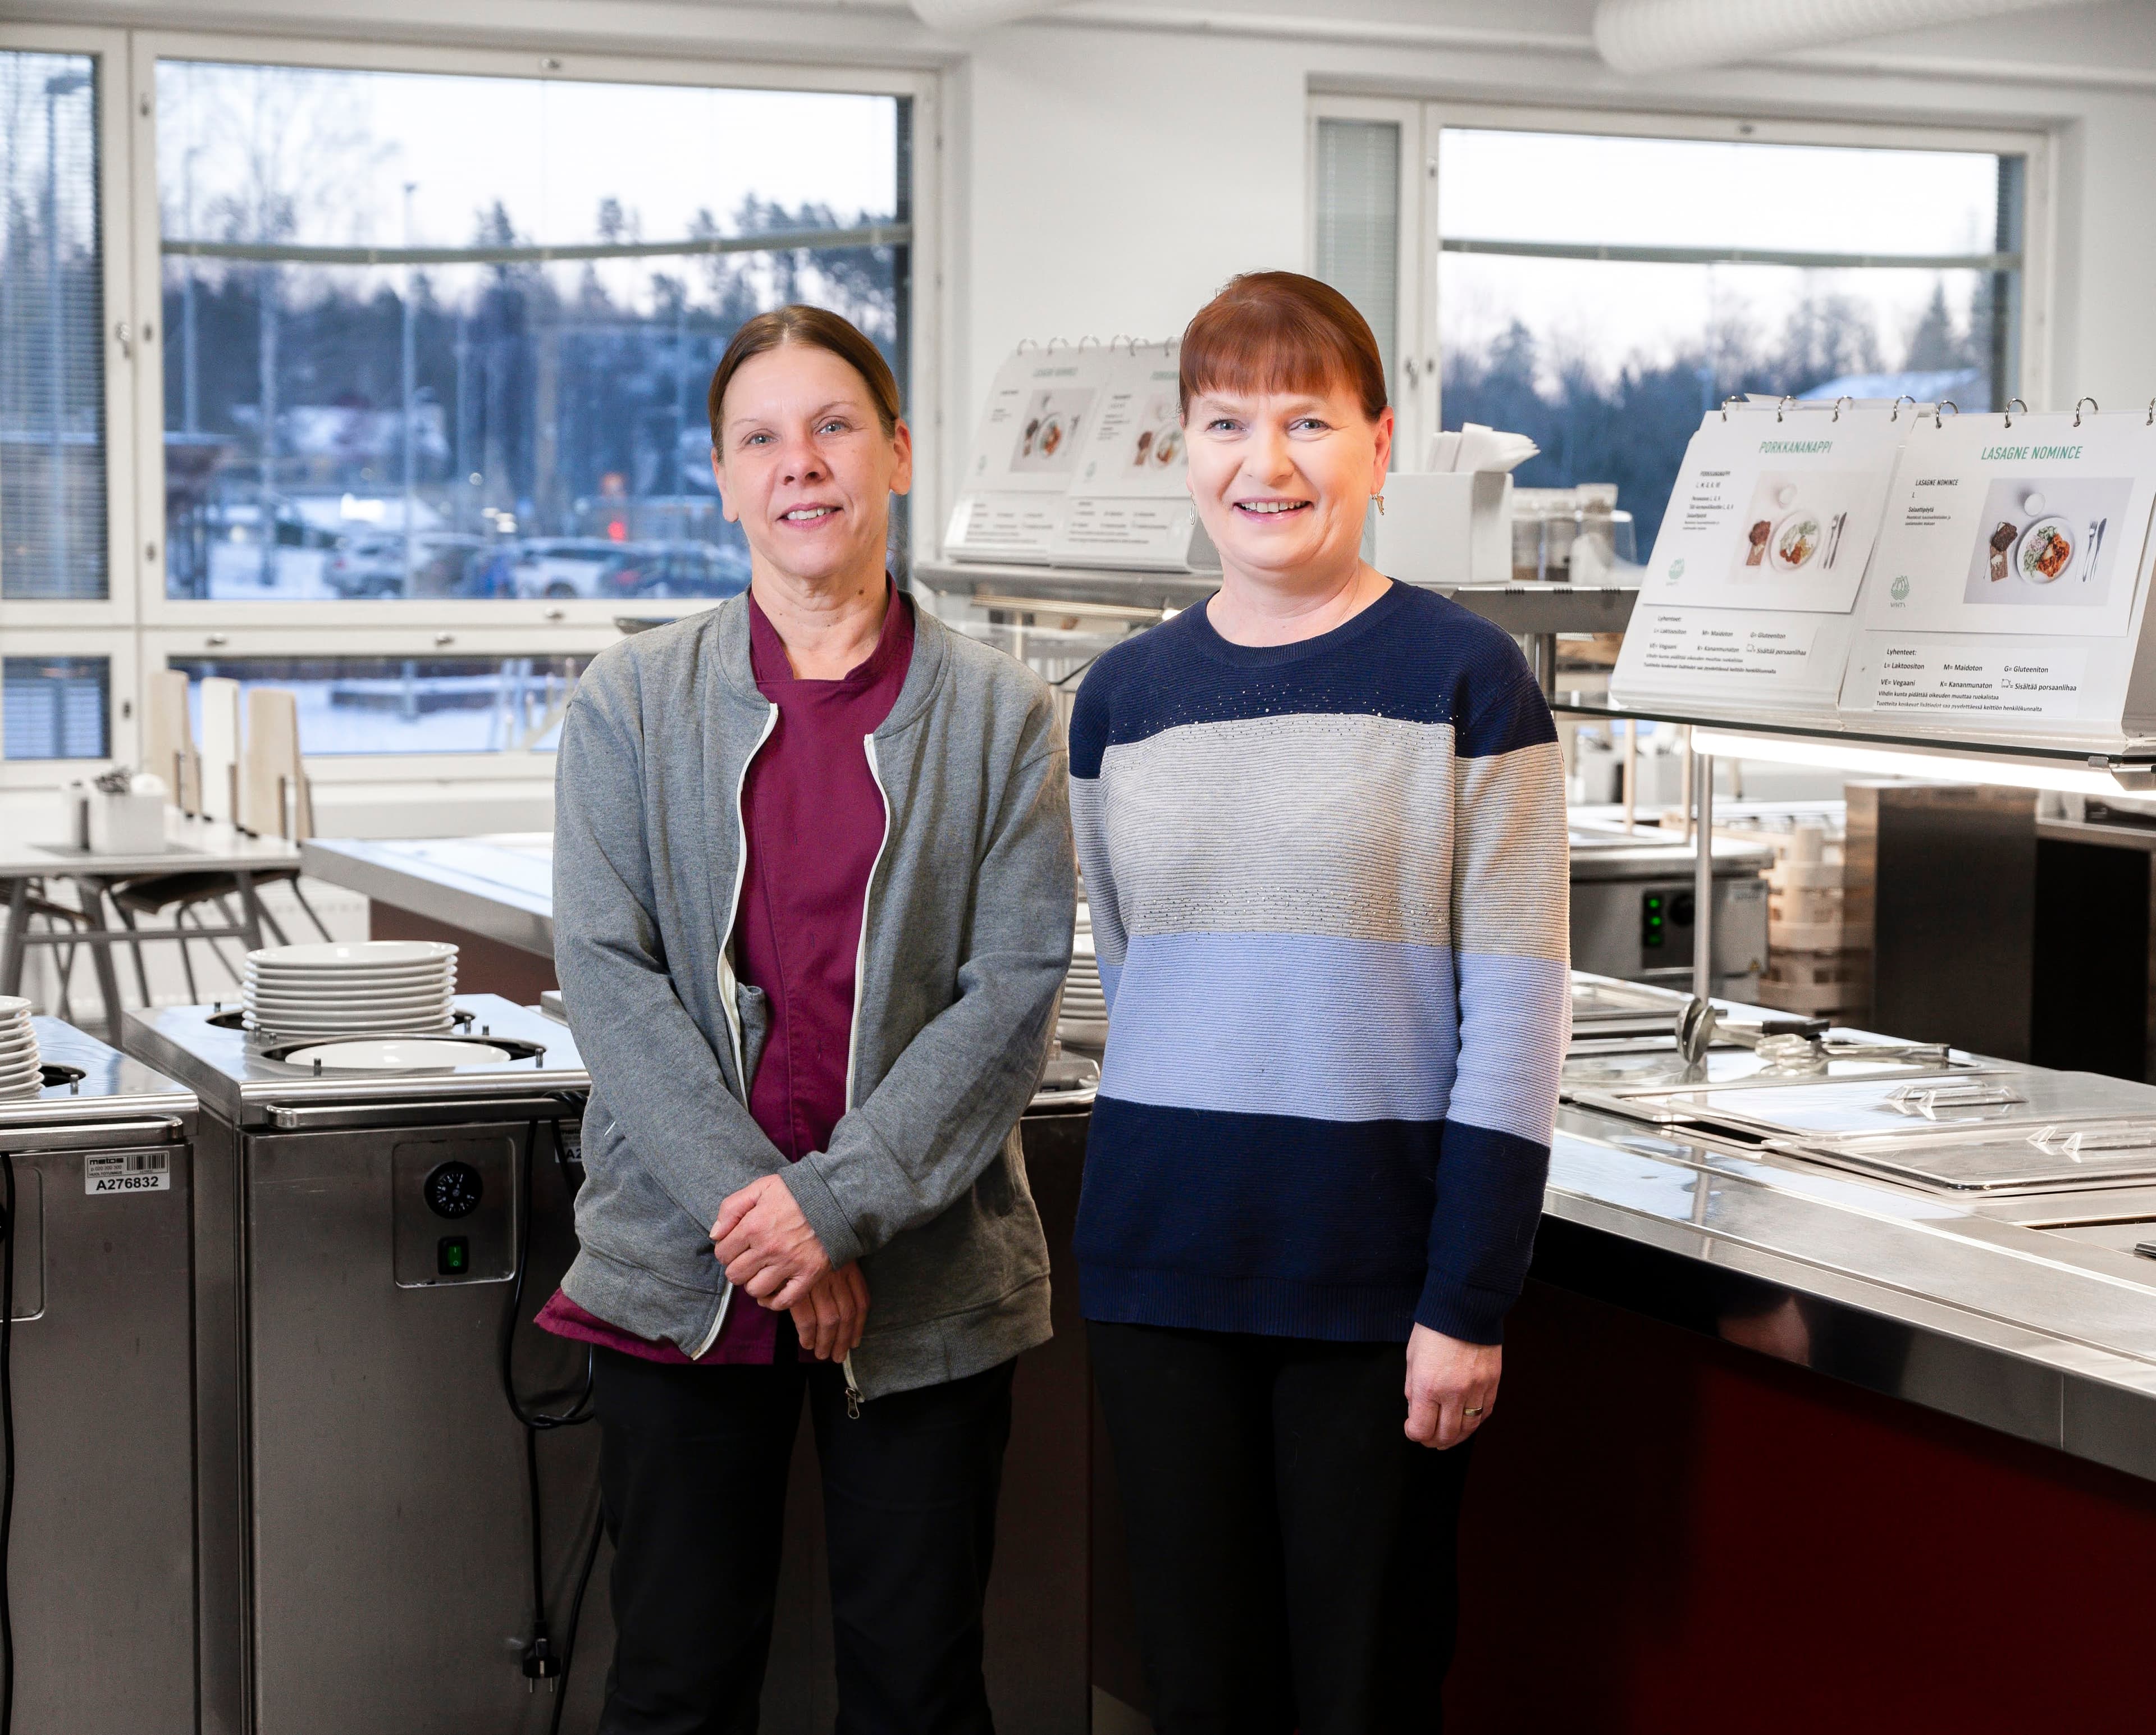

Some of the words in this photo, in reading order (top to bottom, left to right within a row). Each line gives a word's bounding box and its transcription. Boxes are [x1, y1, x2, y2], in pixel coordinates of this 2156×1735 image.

[1758, 441, 1833, 453] PORKKANANAPPI
[1981, 446, 2030, 460] LASAGNE
[2031, 446, 2083, 459] NOMINCE
[96, 1176, 159, 1191] A276832
